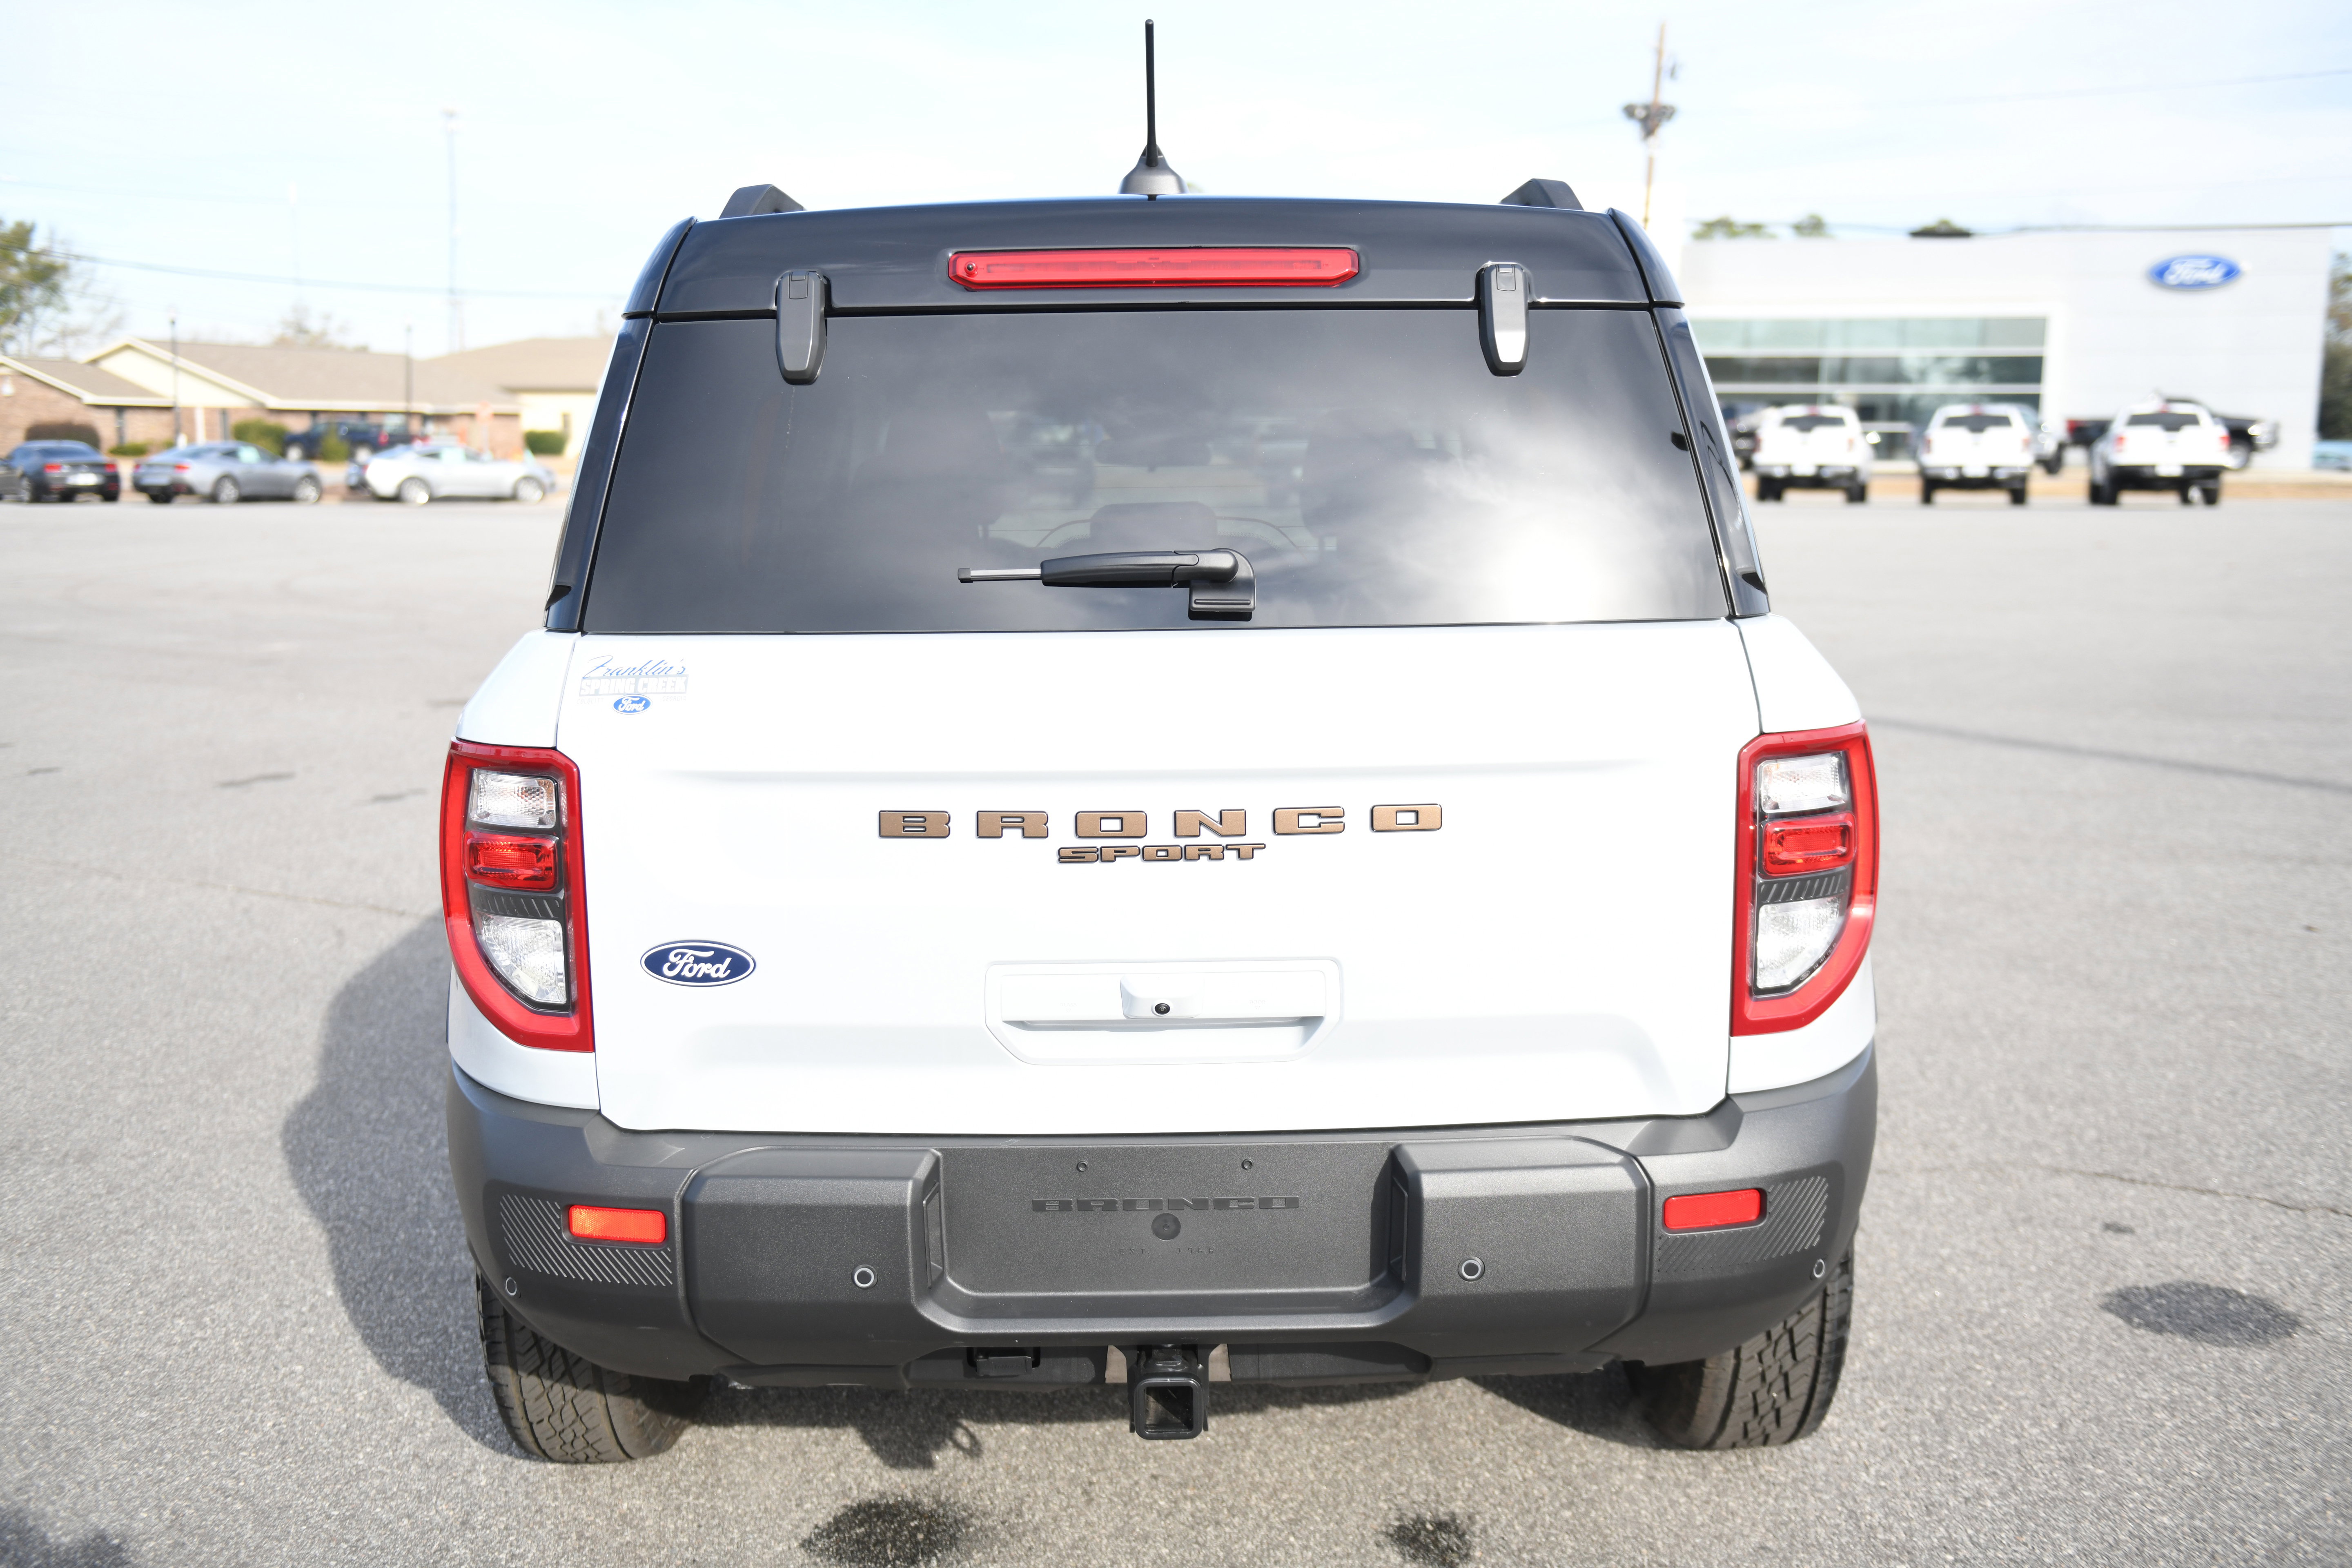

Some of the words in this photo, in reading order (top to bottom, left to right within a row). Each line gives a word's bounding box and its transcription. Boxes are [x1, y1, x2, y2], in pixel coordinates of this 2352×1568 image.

[582, 655, 686, 679] Franklin's
[580, 678, 636, 695] SPRING
[637, 676, 687, 693] CREEK
[618, 697, 646, 712] Ford
[878, 803, 1443, 839] BRONCO
[1057, 843, 1266, 864] SPORT
[663, 948, 732, 978] Ford
[1032, 1196, 1300, 1211] BRONCO
